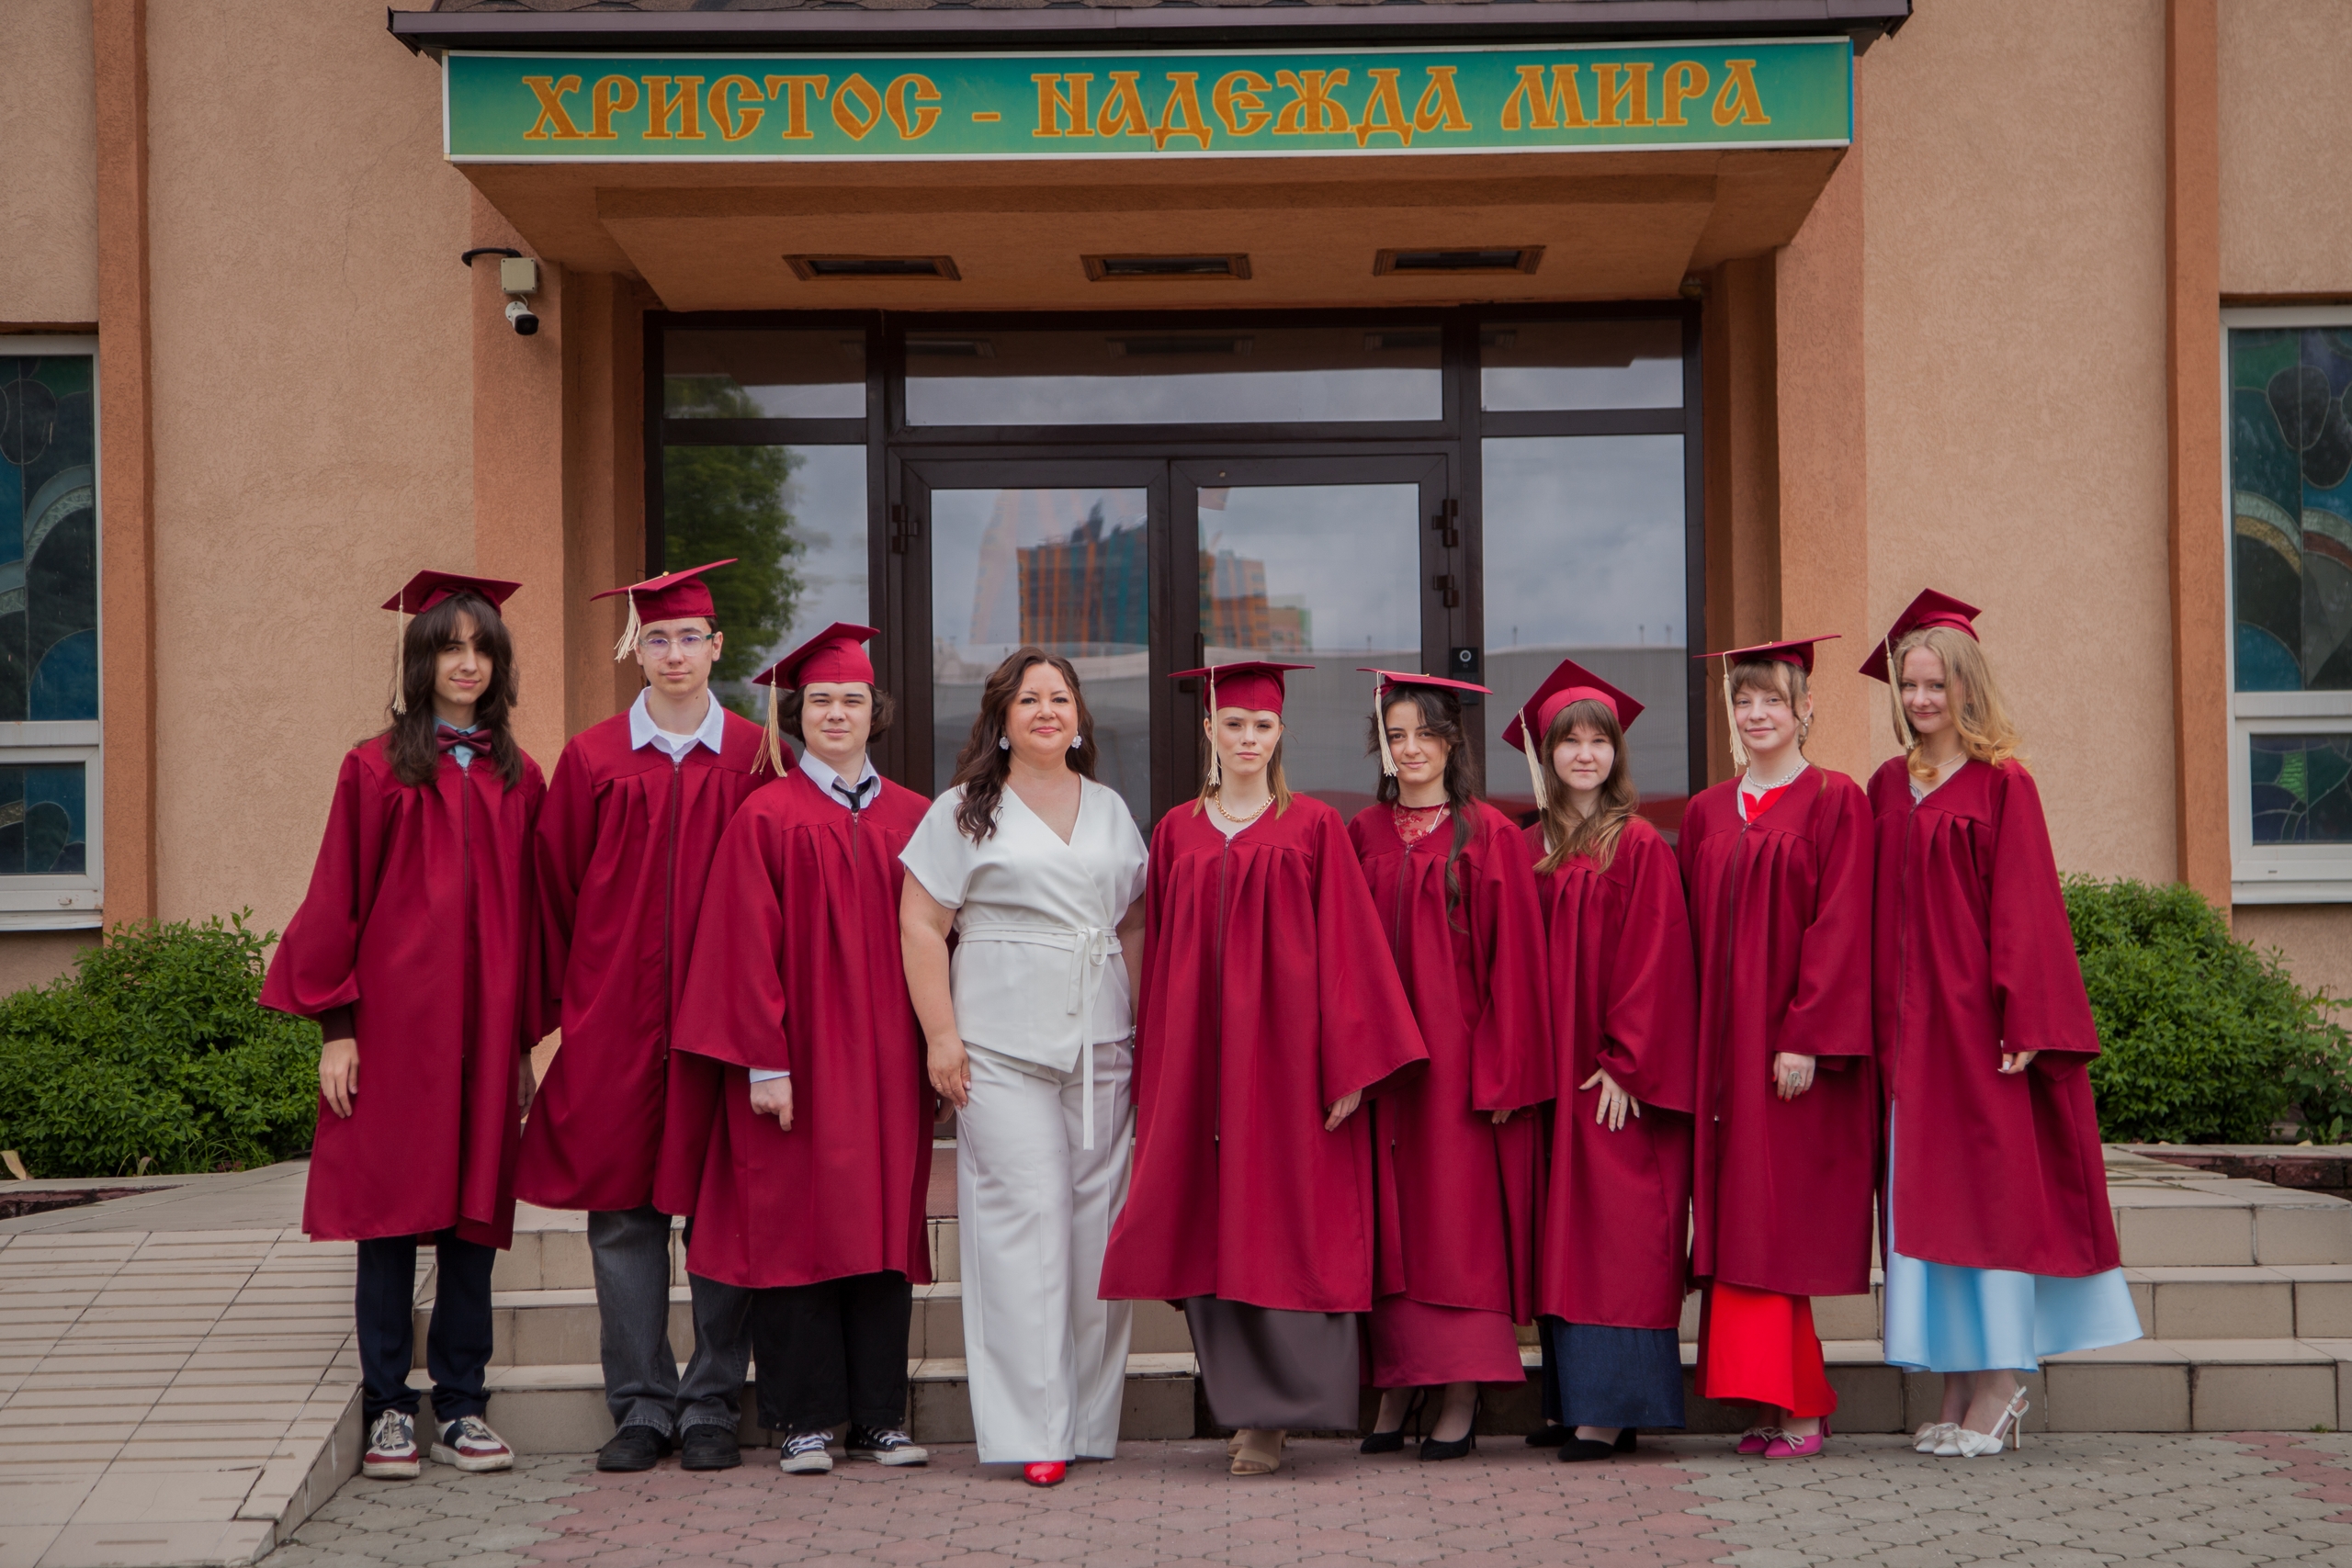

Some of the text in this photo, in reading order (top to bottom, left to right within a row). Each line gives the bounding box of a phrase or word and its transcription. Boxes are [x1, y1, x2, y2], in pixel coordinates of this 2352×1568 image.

[522, 73, 942, 141] ХРИСТОС
[1031, 67, 1473, 150] НАДЕЖДА
[1500, 59, 1772, 130] МИРА
